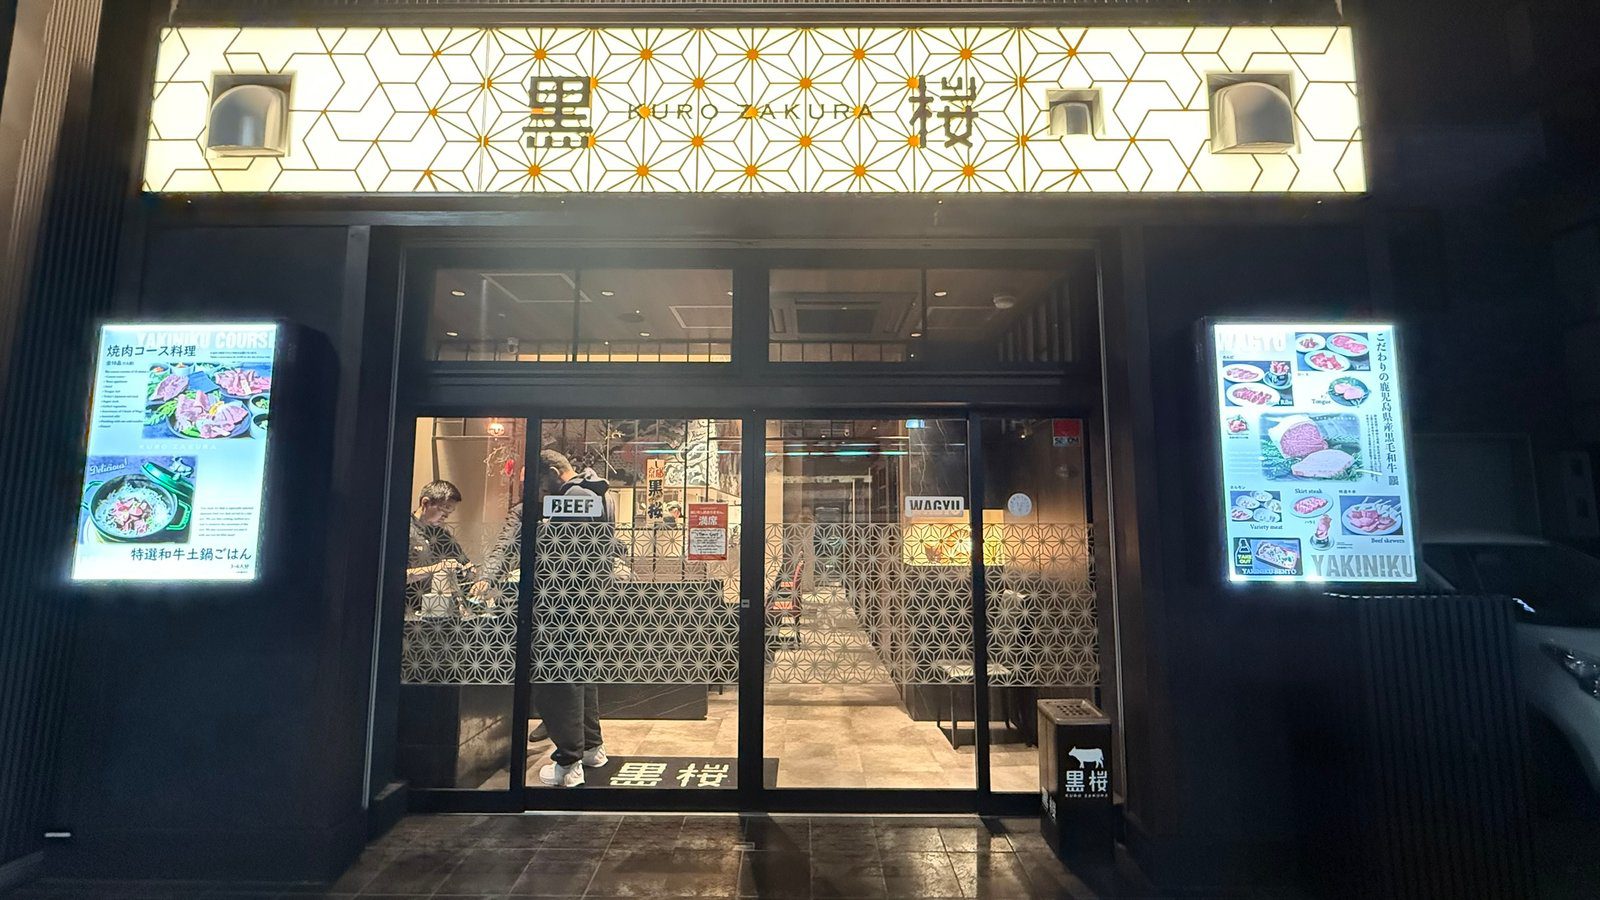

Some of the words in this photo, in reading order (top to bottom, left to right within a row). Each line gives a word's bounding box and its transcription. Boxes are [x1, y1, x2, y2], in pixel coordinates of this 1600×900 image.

[522, 76, 593, 148] 黒
[628, 103, 718, 120] KURO
[737, 103, 875, 120] ZAKURA
[908, 75, 979, 148] 桜
[215, 331, 271, 349] COURS
[107, 344, 196, 358] 焼肉コース料理
[1376, 333, 1398, 473] こだわりの鹿児島県産黒毛和牛
[551, 498, 594, 513] BEEF
[131, 547, 252, 561] 特選和牛土鍋ごはん
[1311, 554, 1413, 577] YAKINIKU
[1065, 770, 1108, 792] 黒桜
